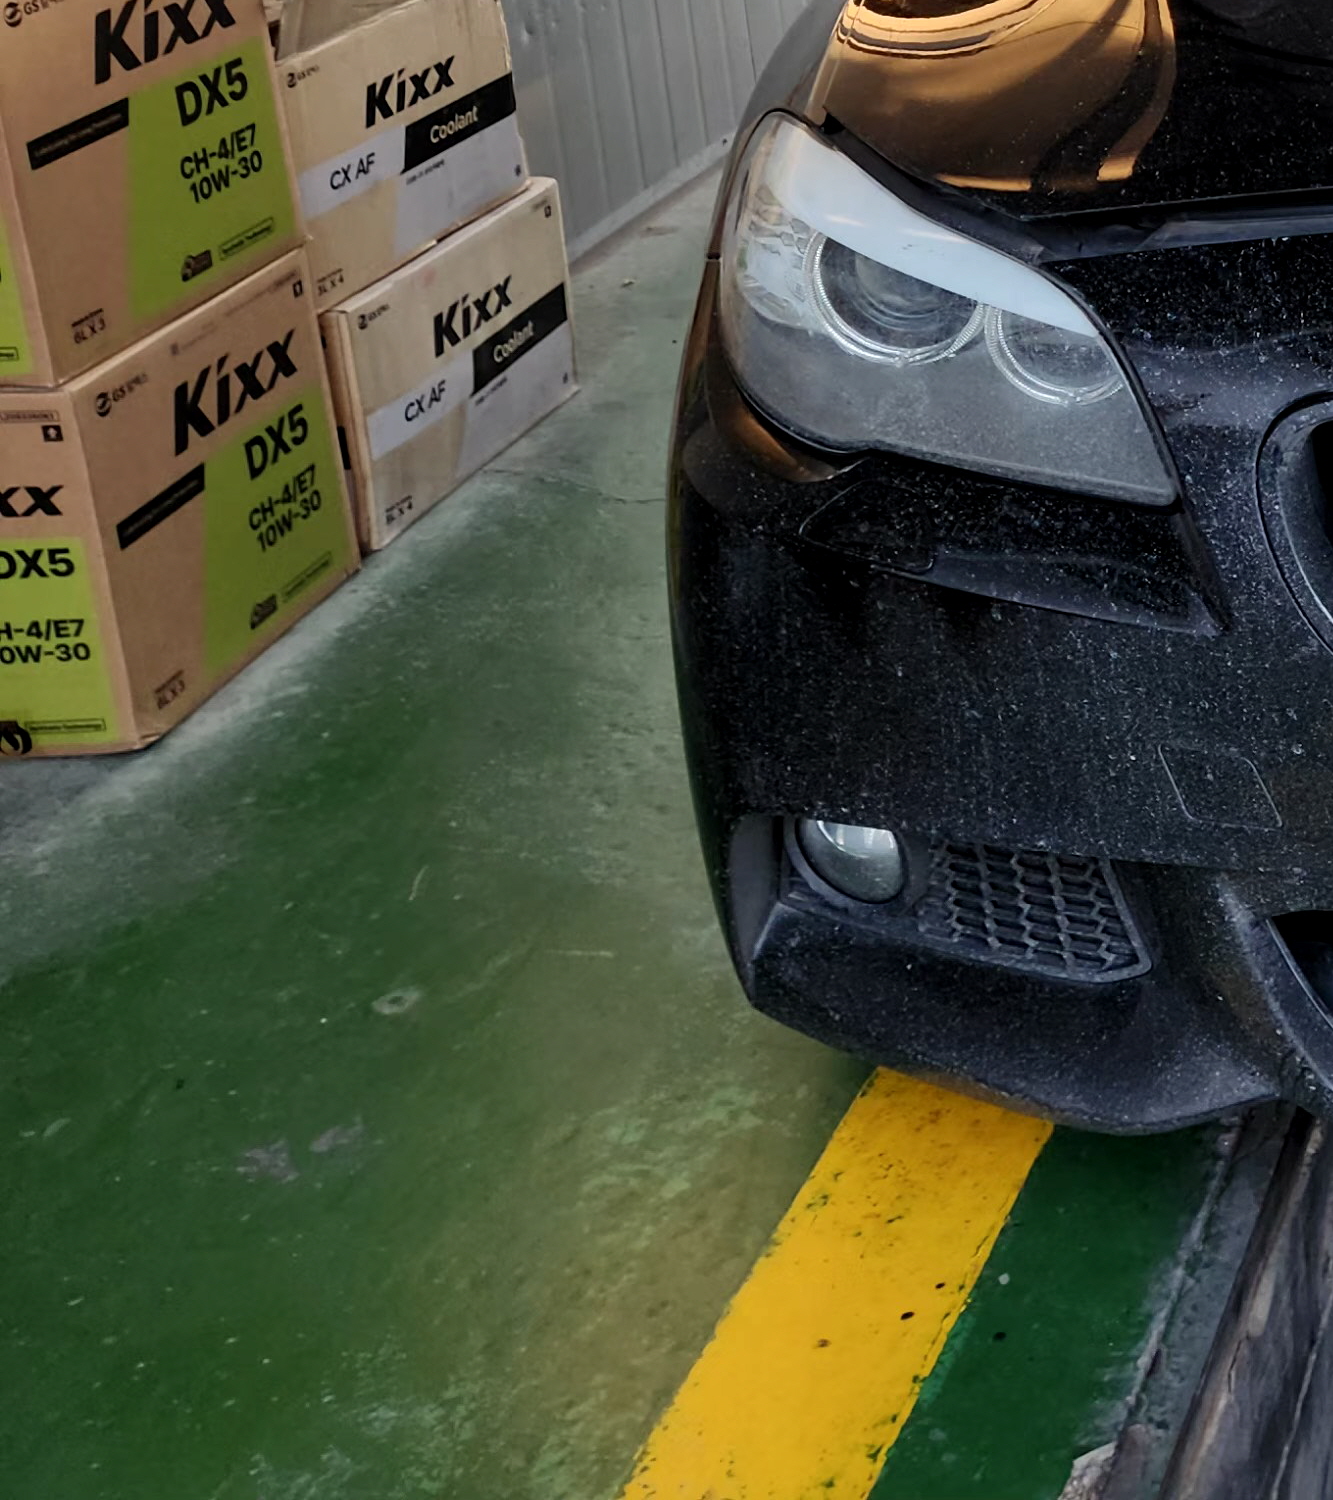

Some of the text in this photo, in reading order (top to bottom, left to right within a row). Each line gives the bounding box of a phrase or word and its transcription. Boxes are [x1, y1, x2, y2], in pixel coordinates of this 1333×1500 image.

[175, 57, 248, 126] DX5
[366, 55, 455, 129] Kixx
[180, 123, 256, 180] CH-4/E7
[430, 105, 479, 144] Coolant
[190, 151, 263, 204] 10W-30
[330, 164, 352, 190] CX
[355, 152, 376, 180] AF
[433, 274, 512, 358] Kixx
[493, 320, 534, 364] Coolant
[174, 328, 298, 457] Kixx
[404, 395, 425, 422] CX
[428, 379, 446, 408] AF
[243, 404, 308, 480] DX5
[248, 463, 316, 531] CH-4/E7
[256, 490, 323, 552] 10W-30
